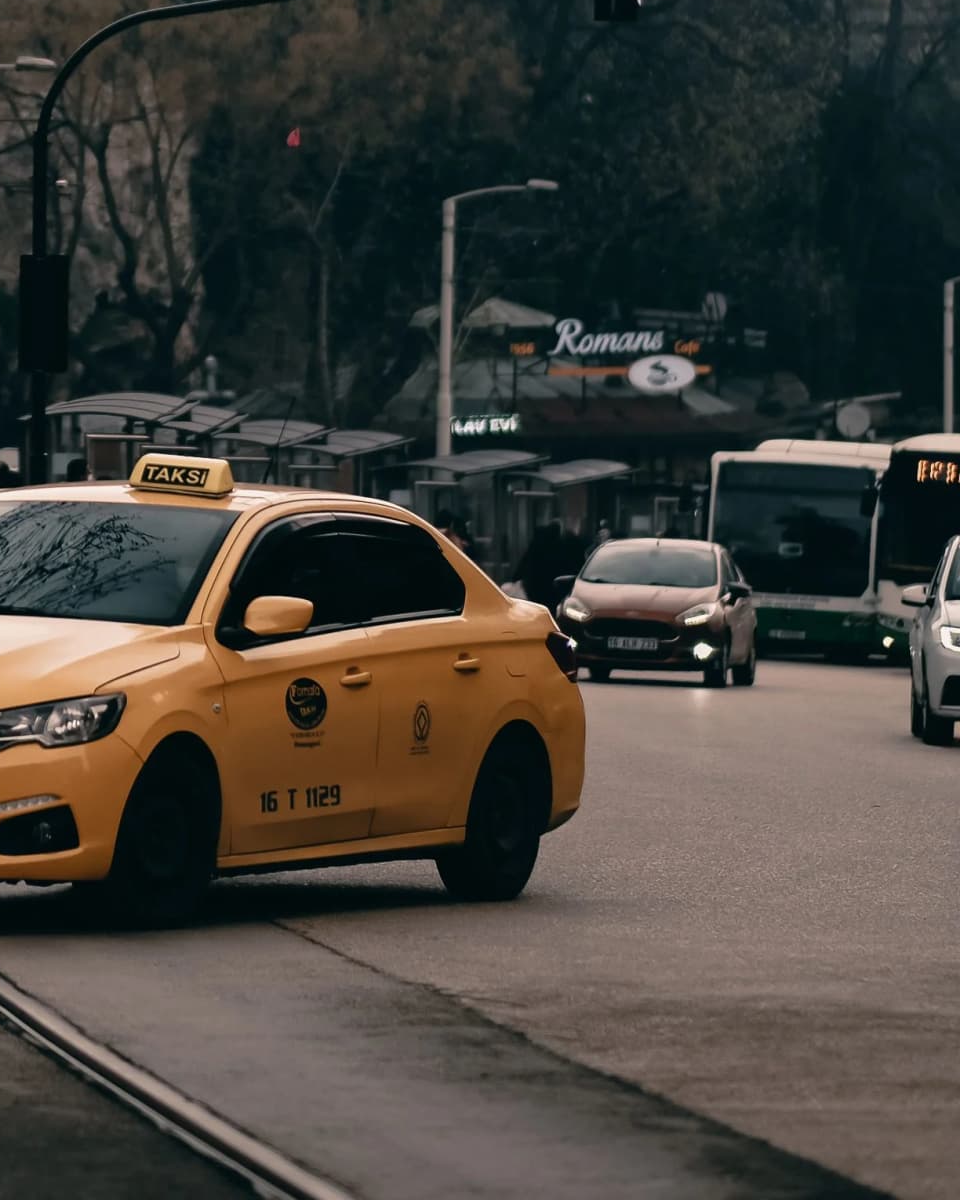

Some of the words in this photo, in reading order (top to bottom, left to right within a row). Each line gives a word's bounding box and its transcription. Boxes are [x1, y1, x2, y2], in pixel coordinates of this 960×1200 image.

[549, 319, 664, 355] Romans
[260, 791, 278, 813] 16
[288, 788, 298, 810] T
[306, 784, 341, 808] 1129
